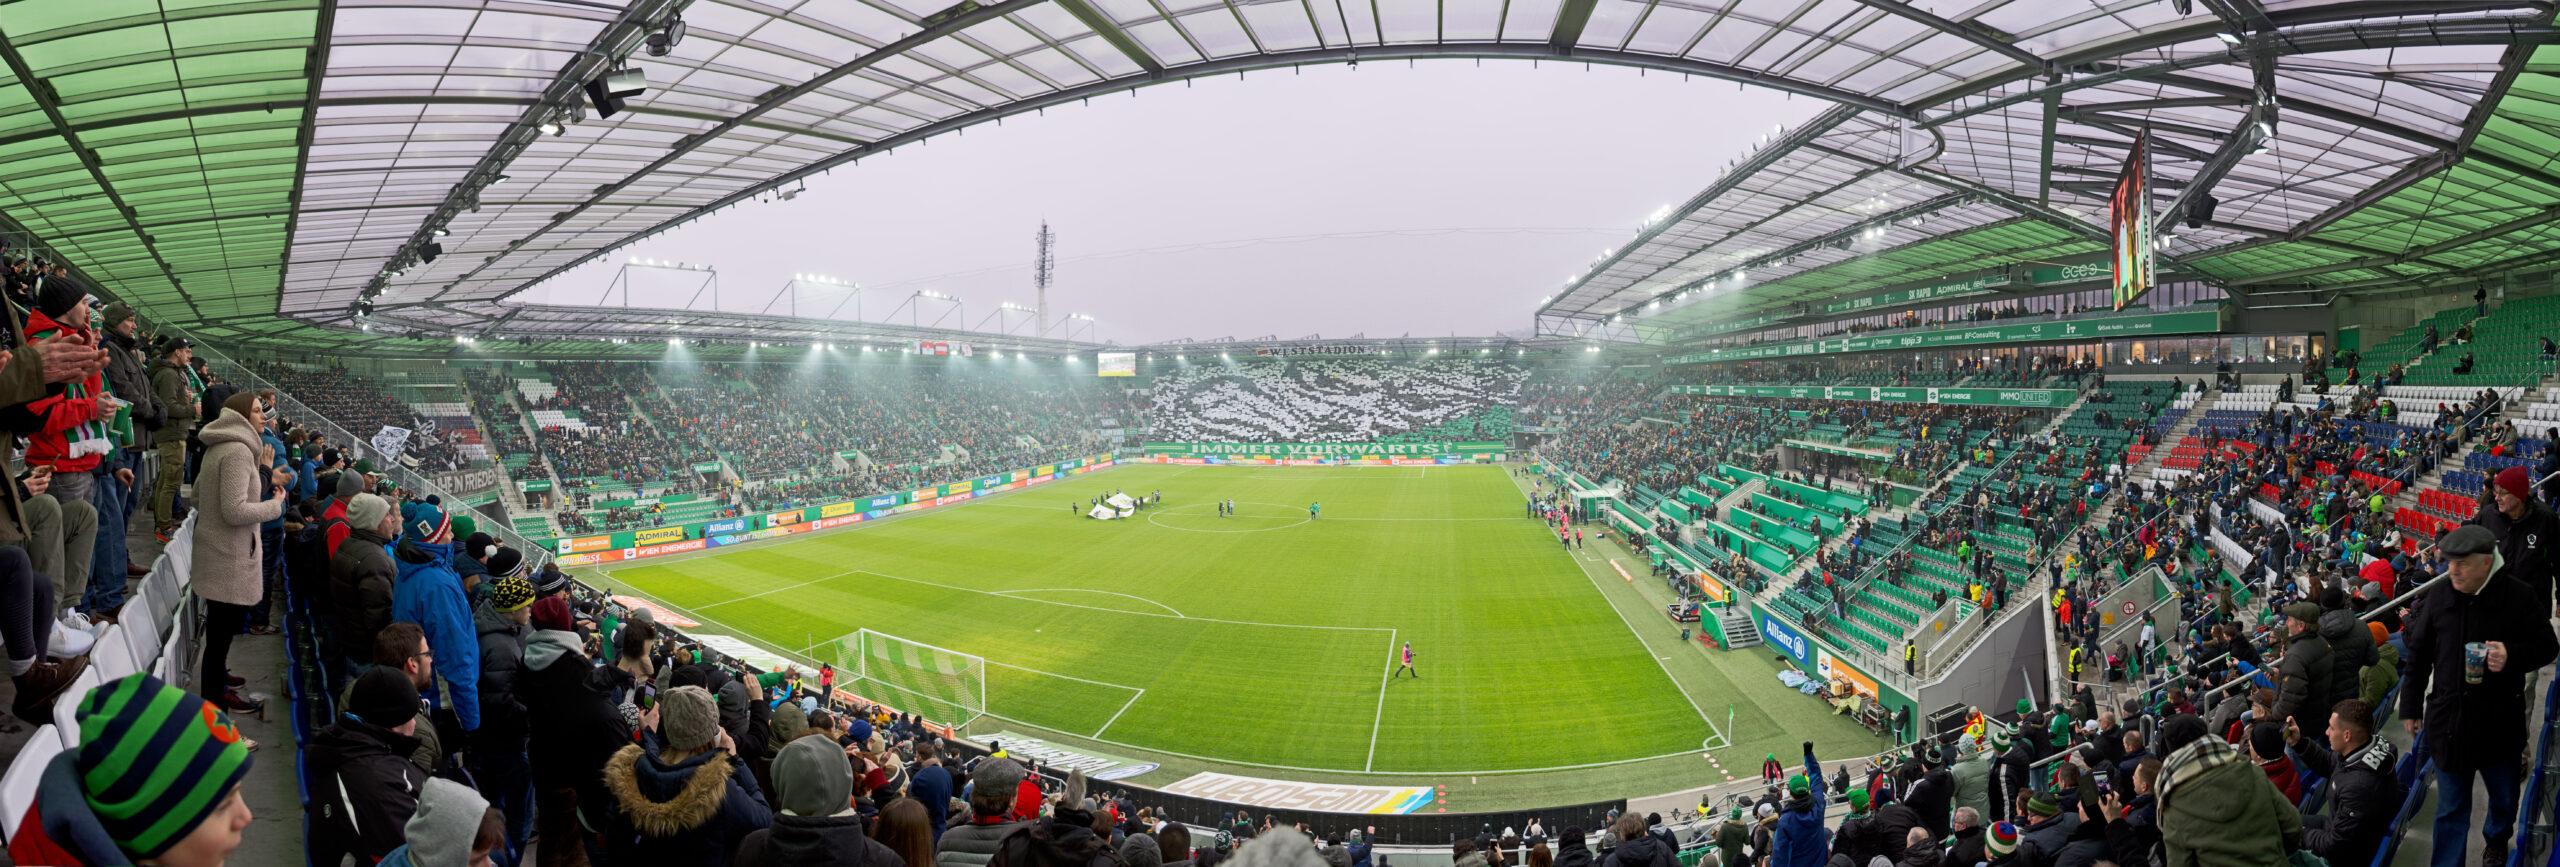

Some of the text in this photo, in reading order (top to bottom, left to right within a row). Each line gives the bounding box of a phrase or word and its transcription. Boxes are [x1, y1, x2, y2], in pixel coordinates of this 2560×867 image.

[1936, 282, 1971, 295] ADMIRAL
[1190, 444, 1281, 454] IMMER
[709, 523, 734, 532] Allianz
[638, 530, 682, 542] ADMIRAL
[1766, 620, 1793, 650] Allianz
